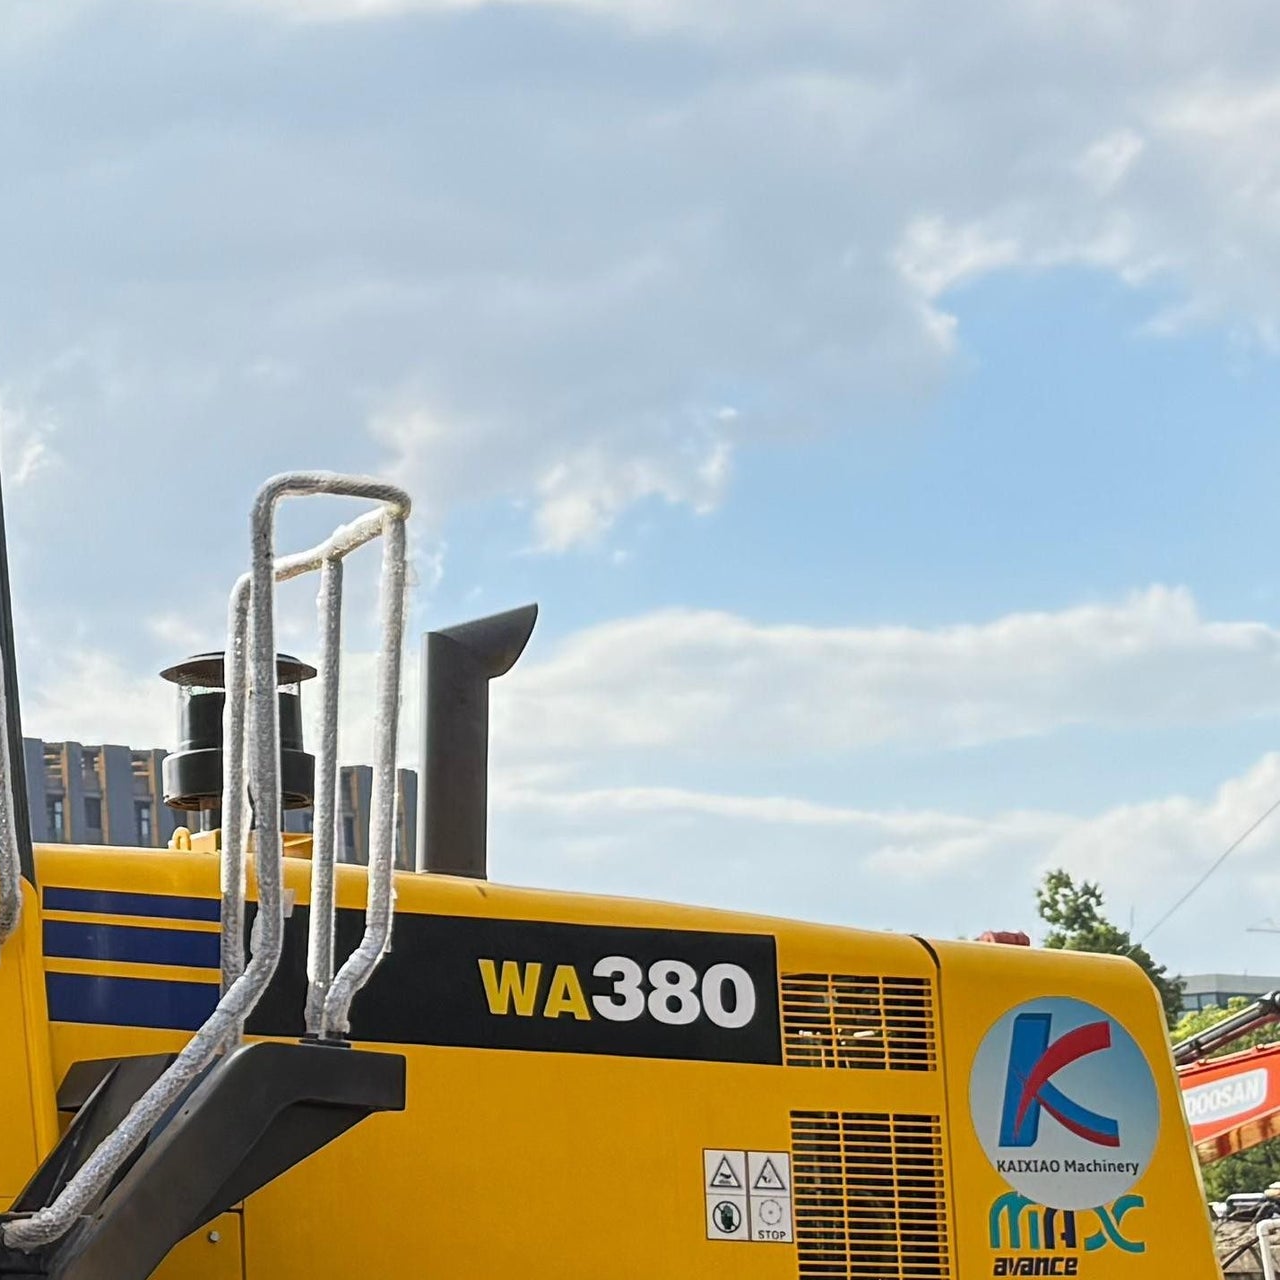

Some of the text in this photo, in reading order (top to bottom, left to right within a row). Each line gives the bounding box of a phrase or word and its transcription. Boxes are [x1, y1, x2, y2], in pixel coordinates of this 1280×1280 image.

[478, 956, 756, 1029] WA380
[997, 1159, 1140, 1176] KAIXIAO Machinery
[758, 1229, 787, 1240] STOP
[993, 1256, 1078, 1276] avance
